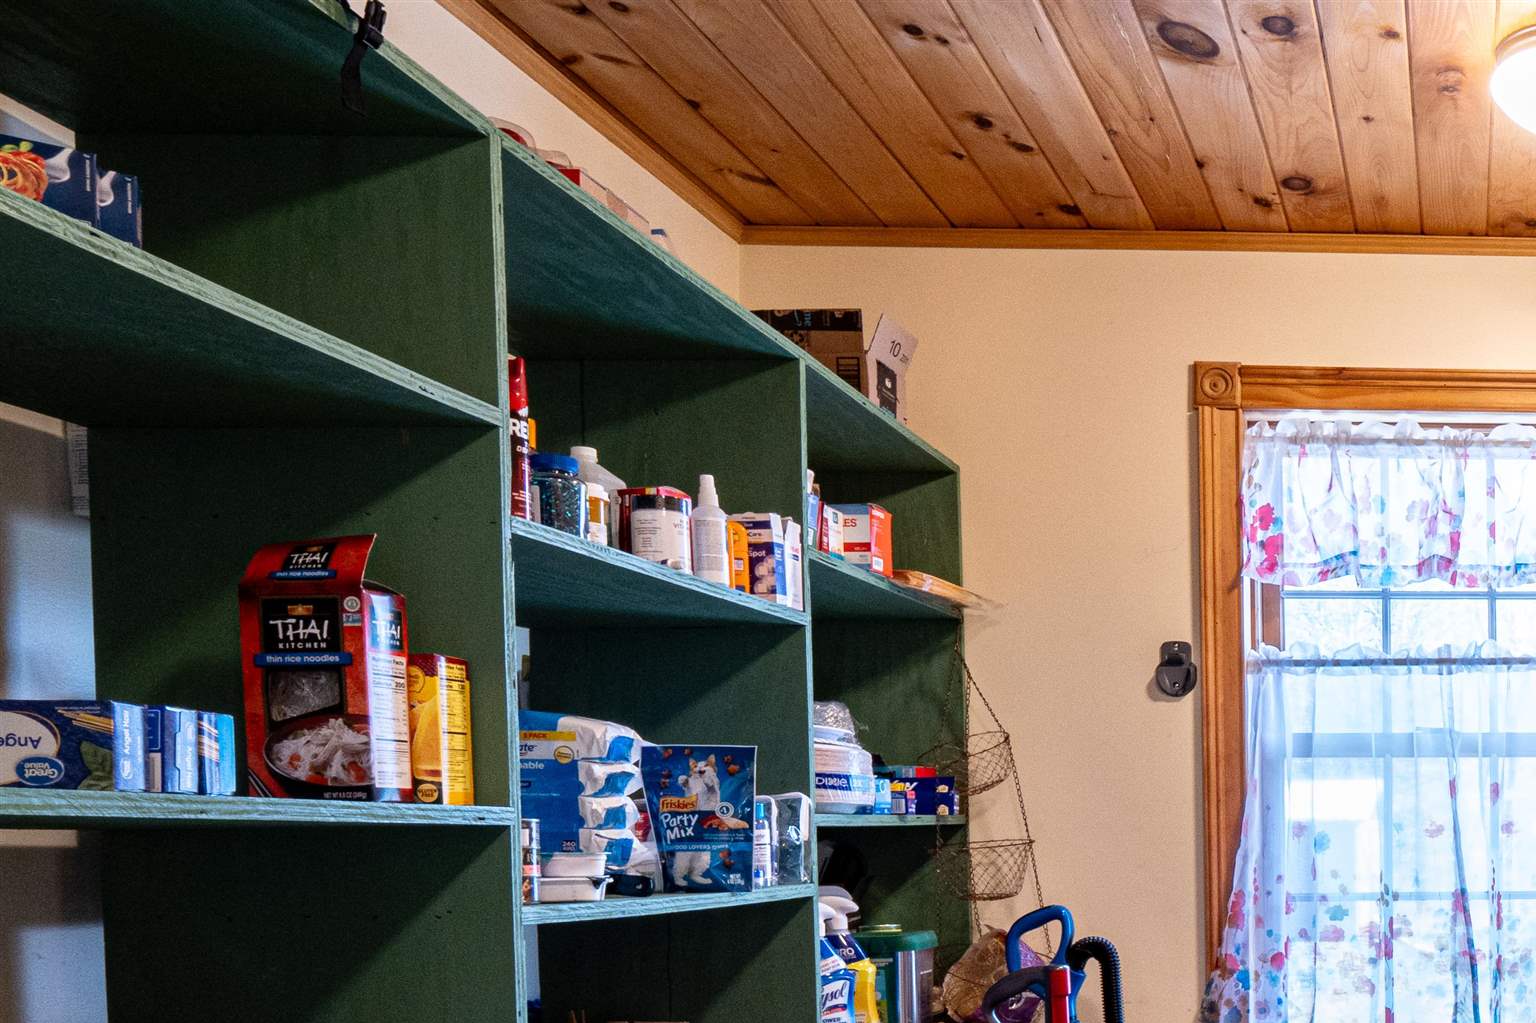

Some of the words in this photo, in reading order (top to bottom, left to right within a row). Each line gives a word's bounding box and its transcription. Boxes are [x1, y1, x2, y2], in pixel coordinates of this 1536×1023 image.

[290, 552, 329, 564] THAI
[268, 618, 330, 641] THAI
[266, 654, 283, 663] thin
[284, 655, 301, 663] rice
[303, 654, 340, 663] noodles
[24, 762, 50, 770] Value
[24, 768, 58, 779] Great
[660, 798, 697, 811] Friskies
[660, 813, 699, 829] Party
[665, 825, 695, 845] Mix
[820, 981, 846, 1010] ysol
